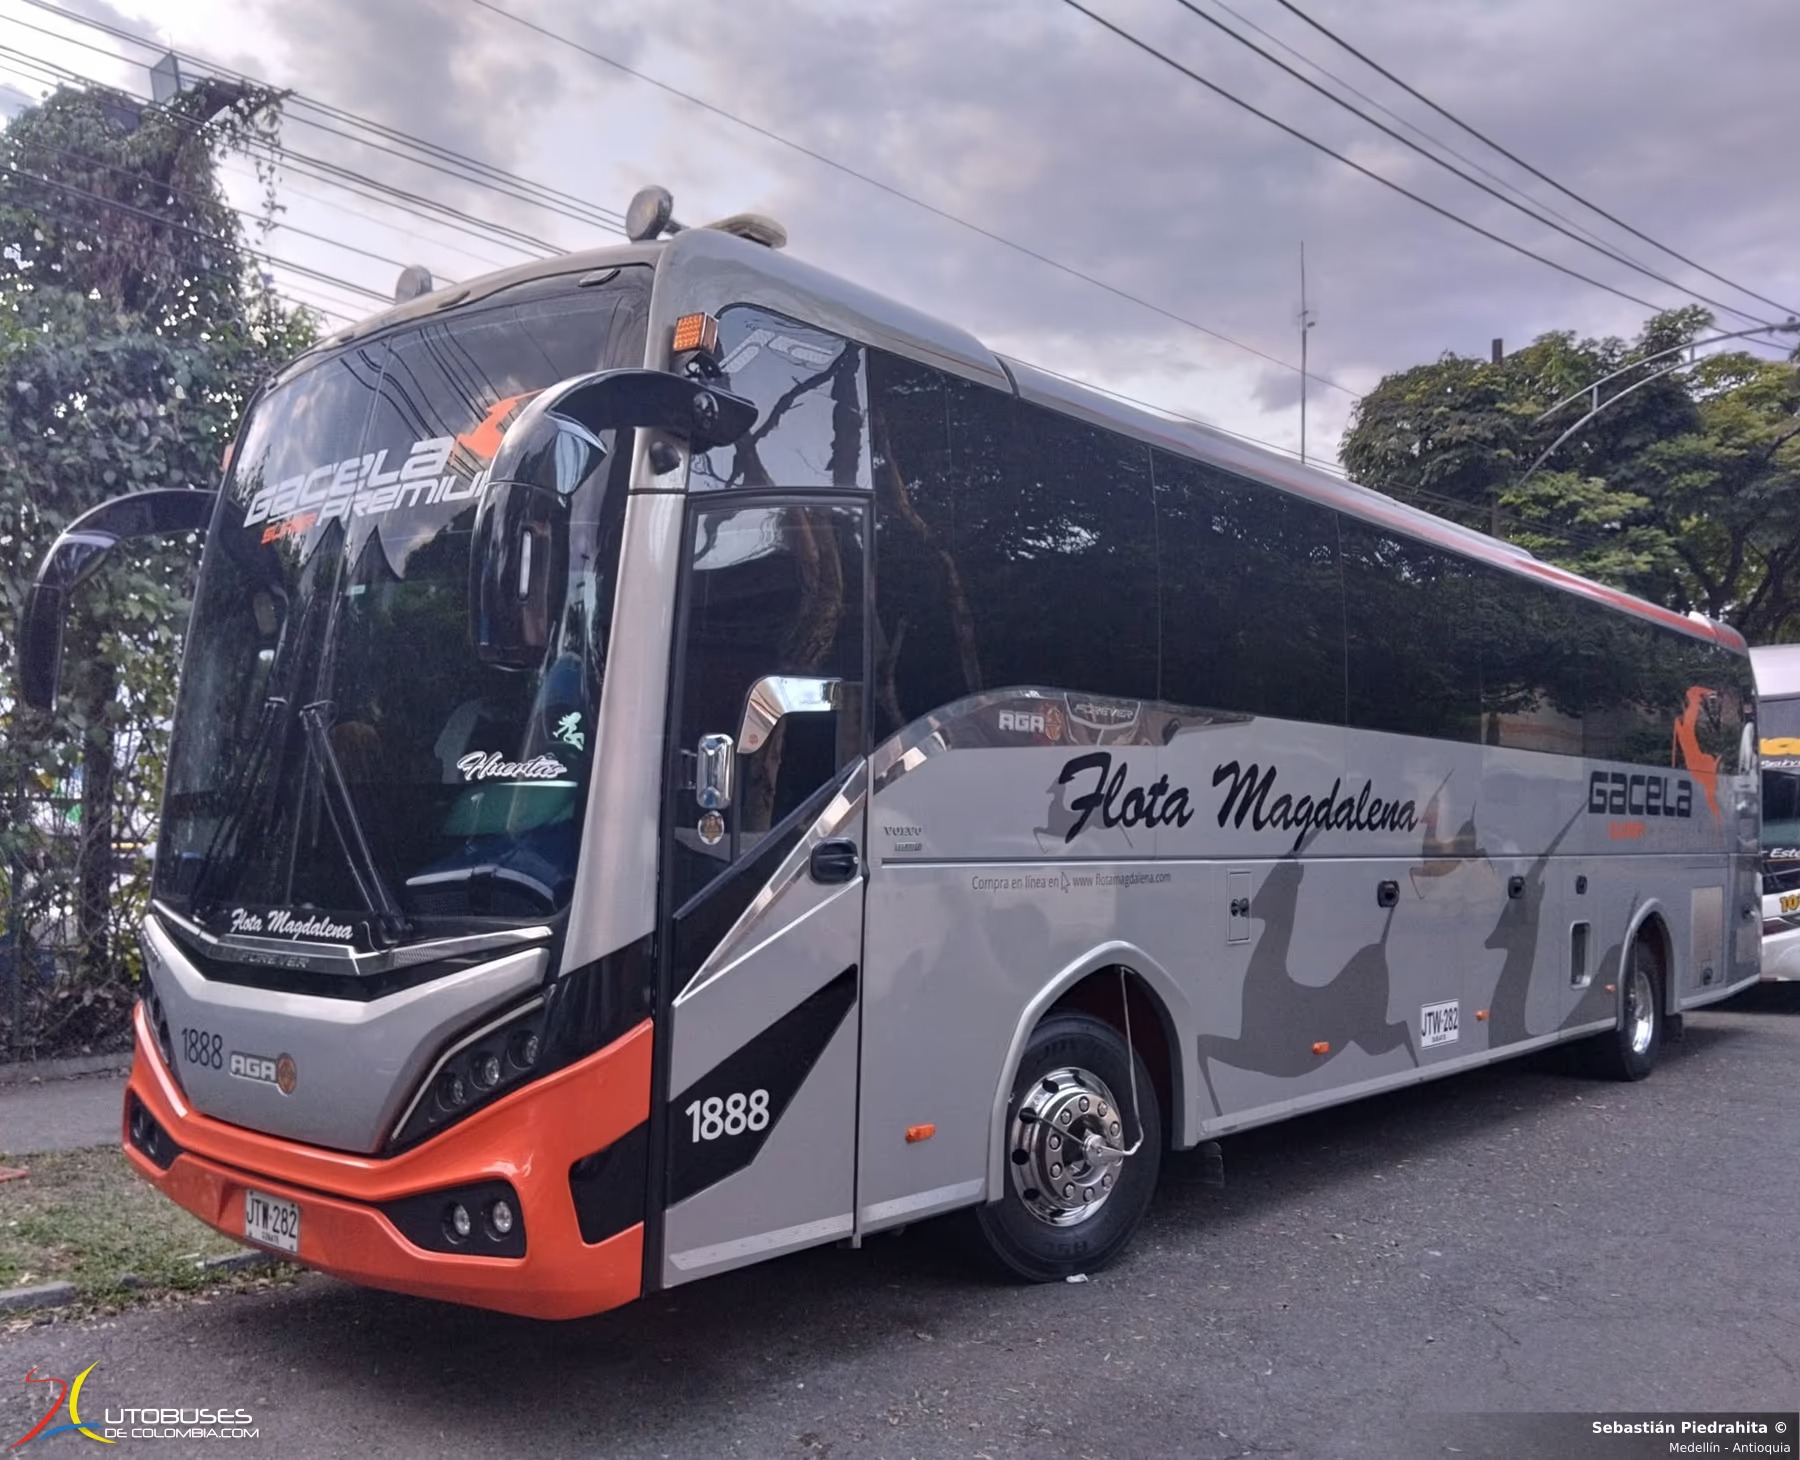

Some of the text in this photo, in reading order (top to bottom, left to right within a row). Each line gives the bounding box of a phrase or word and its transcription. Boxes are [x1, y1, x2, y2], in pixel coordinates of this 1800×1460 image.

[999, 711, 1045, 733] AGA
[457, 751, 568, 780] Huertas
[1058, 751, 1418, 852] Flota Magdalena
[883, 825, 922, 837] VOLVO
[972, 875, 1009, 893] Compra
[1012, 878, 1023, 889] en
[1049, 877, 1060, 888] en
[231, 908, 353, 941] Flota Magdalena
[1421, 1007, 1458, 1037] JTW-282
[181, 1027, 223, 1069] 1888
[230, 1054, 277, 1081] AGA
[685, 1089, 770, 1143] 1888
[246, 1198, 297, 1239] JTW-282
